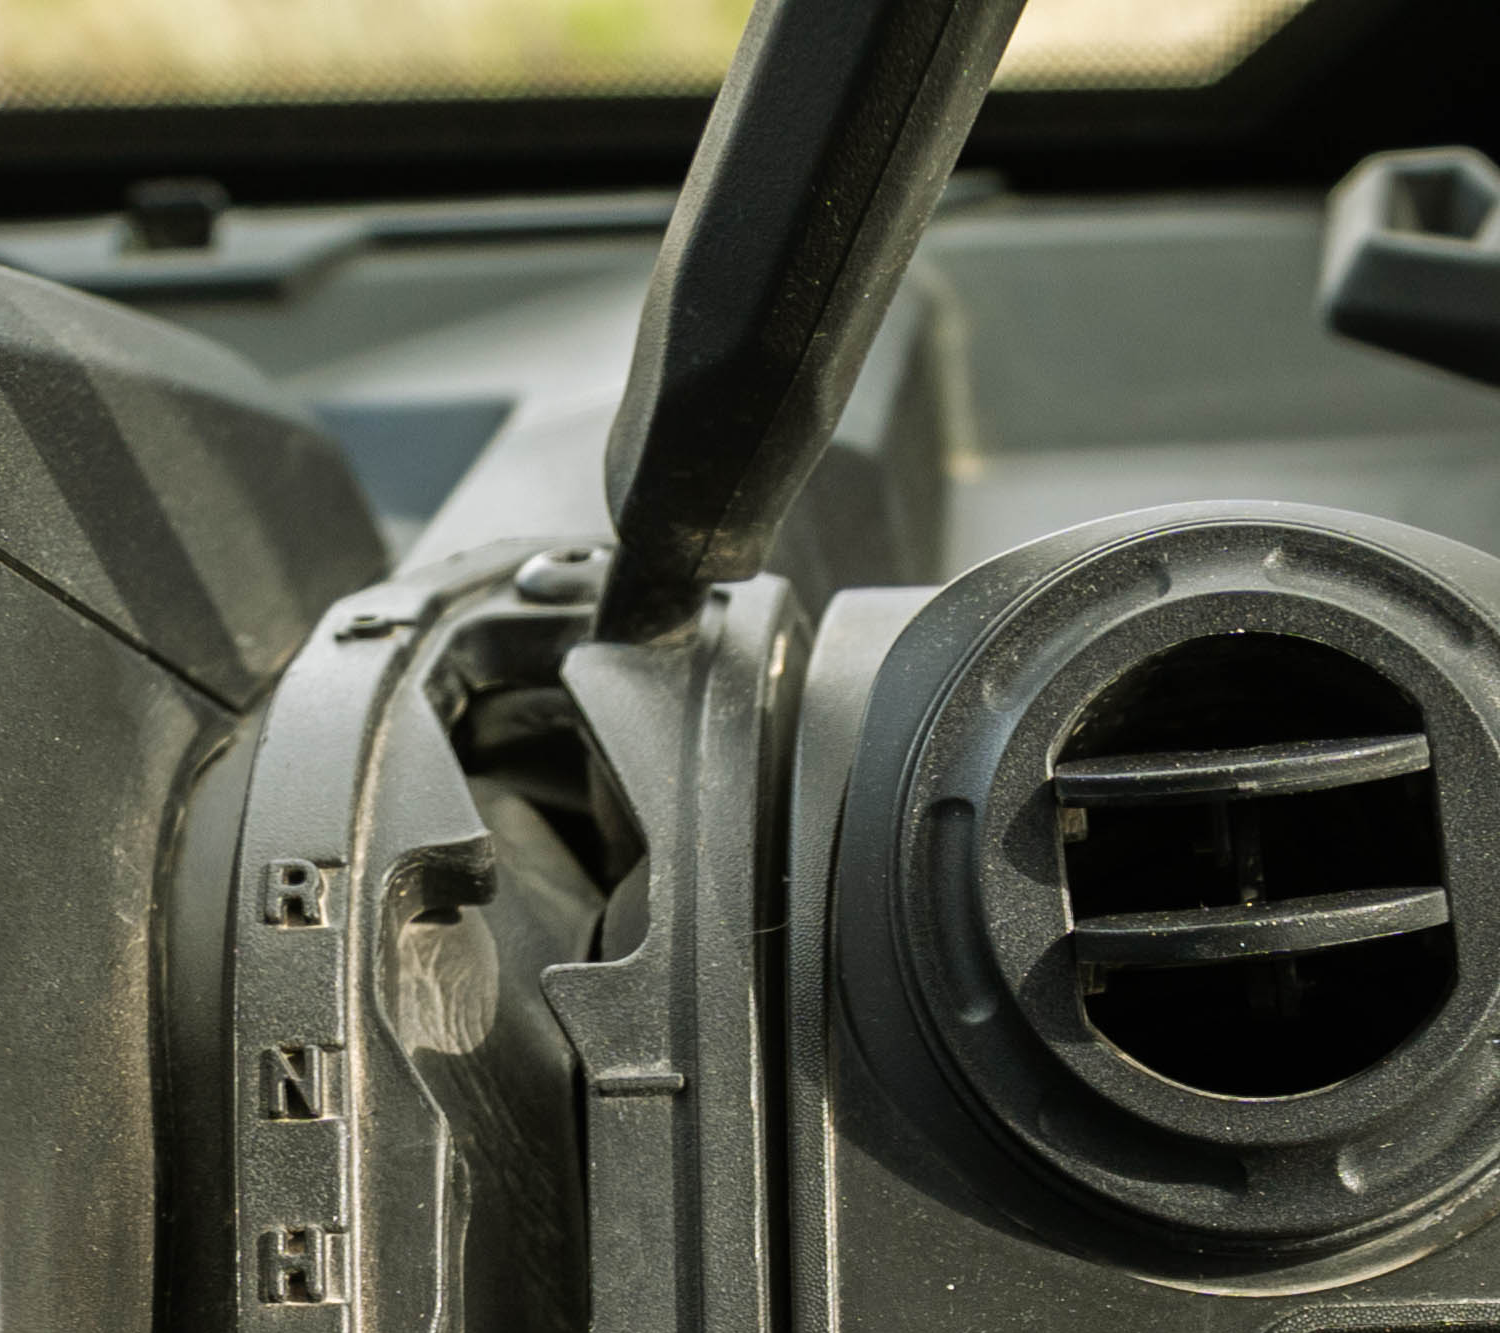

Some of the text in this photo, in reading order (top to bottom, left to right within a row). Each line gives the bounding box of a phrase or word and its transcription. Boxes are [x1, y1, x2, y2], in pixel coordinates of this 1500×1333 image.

[265, 859, 324, 926] R
[261, 1046, 323, 1118] N
[258, 1228, 328, 1303] H
